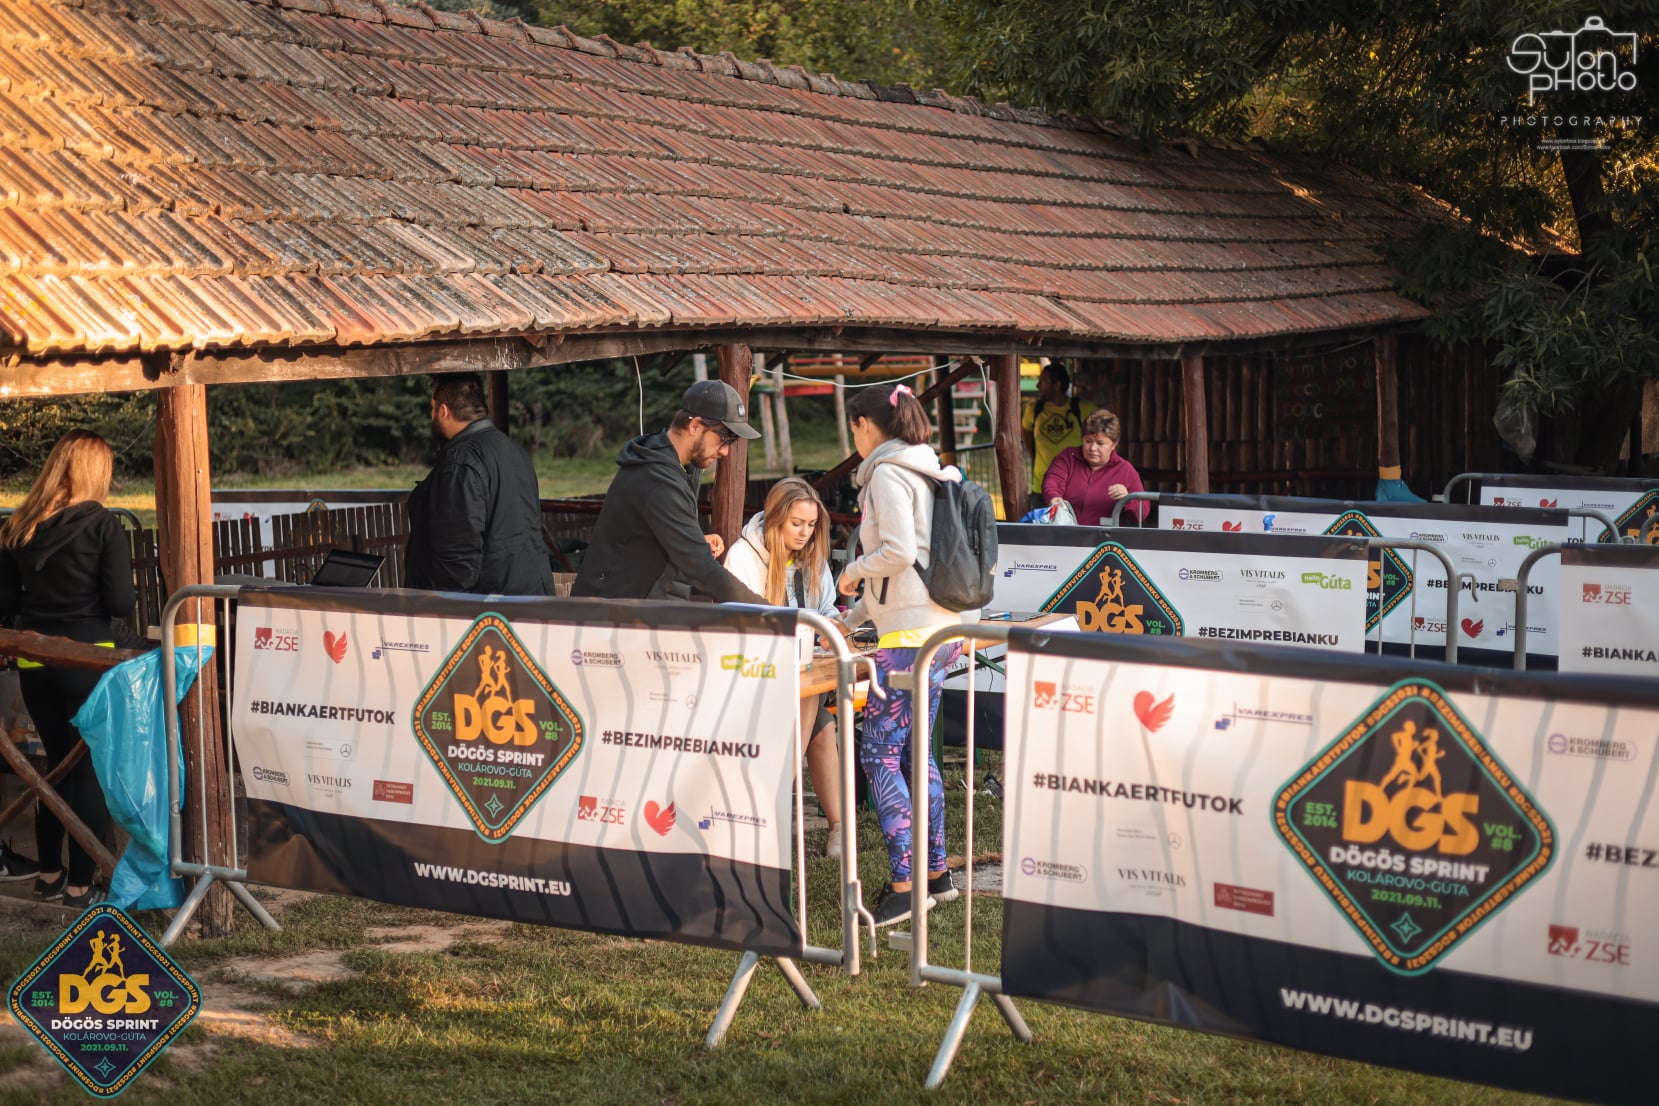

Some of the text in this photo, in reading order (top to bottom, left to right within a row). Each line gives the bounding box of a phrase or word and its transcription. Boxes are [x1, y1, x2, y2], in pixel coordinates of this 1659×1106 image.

[1240, 569, 1285, 579] VIS VITALIS
[1320, 574, 1351, 590] Gúta
[1605, 591, 1632, 605] ZSE
[1076, 601, 1144, 634] DGS
[1146, 620, 1166, 628] VOL.
[1198, 626, 1339, 646] #BEZIMPREBIANKU
[1427, 623, 1447, 633] ZSE
[275, 635, 299, 651] ZSE
[383, 640, 430, 650] VAREXPRES
[583, 651, 619, 660] KROMBERG
[646, 651, 702, 664] VIS VITALIS
[740, 656, 776, 679] Gúta
[1061, 692, 1095, 714] ZSE
[250, 700, 395, 725] #BIANKAERTFUTOK
[432, 712, 452, 722] EST.
[453, 693, 538, 746] DGS
[1238, 708, 1313, 722] VAREXPRES
[431, 721, 452, 731] 2014
[539, 720, 563, 732] VOL.
[545, 731, 558, 741] #8
[602, 731, 760, 759] #BEZIMPREBIANKU
[1569, 738, 1627, 751] KROMBERG
[447, 744, 545, 767] DÖGÖS SPRINT
[458, 762, 533, 779] KOLÁROVO-GÚTA
[307, 773, 352, 788] VIS VITALIS
[472, 776, 516, 789] 2021.09.11.
[1033, 773, 1244, 816] #BIANKAERTFUTOK
[600, 807, 625, 825] ZSE
[1305, 801, 1337, 816] EST.
[714, 811, 767, 824] VAREXPRES
[1303, 814, 1338, 829] 2014
[1342, 779, 1480, 856] DGS
[1483, 823, 1522, 840] VOL.
[1491, 837, 1514, 852] #8
[1037, 861, 1079, 873] KROMBERG
[1329, 844, 1490, 884] DÖGÖS SPRINT
[414, 862, 572, 896] WWW.DGSPRINT.EU
[1118, 868, 1187, 888] VIS VITALIS
[1347, 869, 1470, 897] KOLÁROVO-GÚTA
[1370, 888, 1442, 910] 2021.09.11.
[1585, 940, 1630, 966] ZSE
[1280, 987, 1534, 1051] WWW.DGSPRINT.EU
